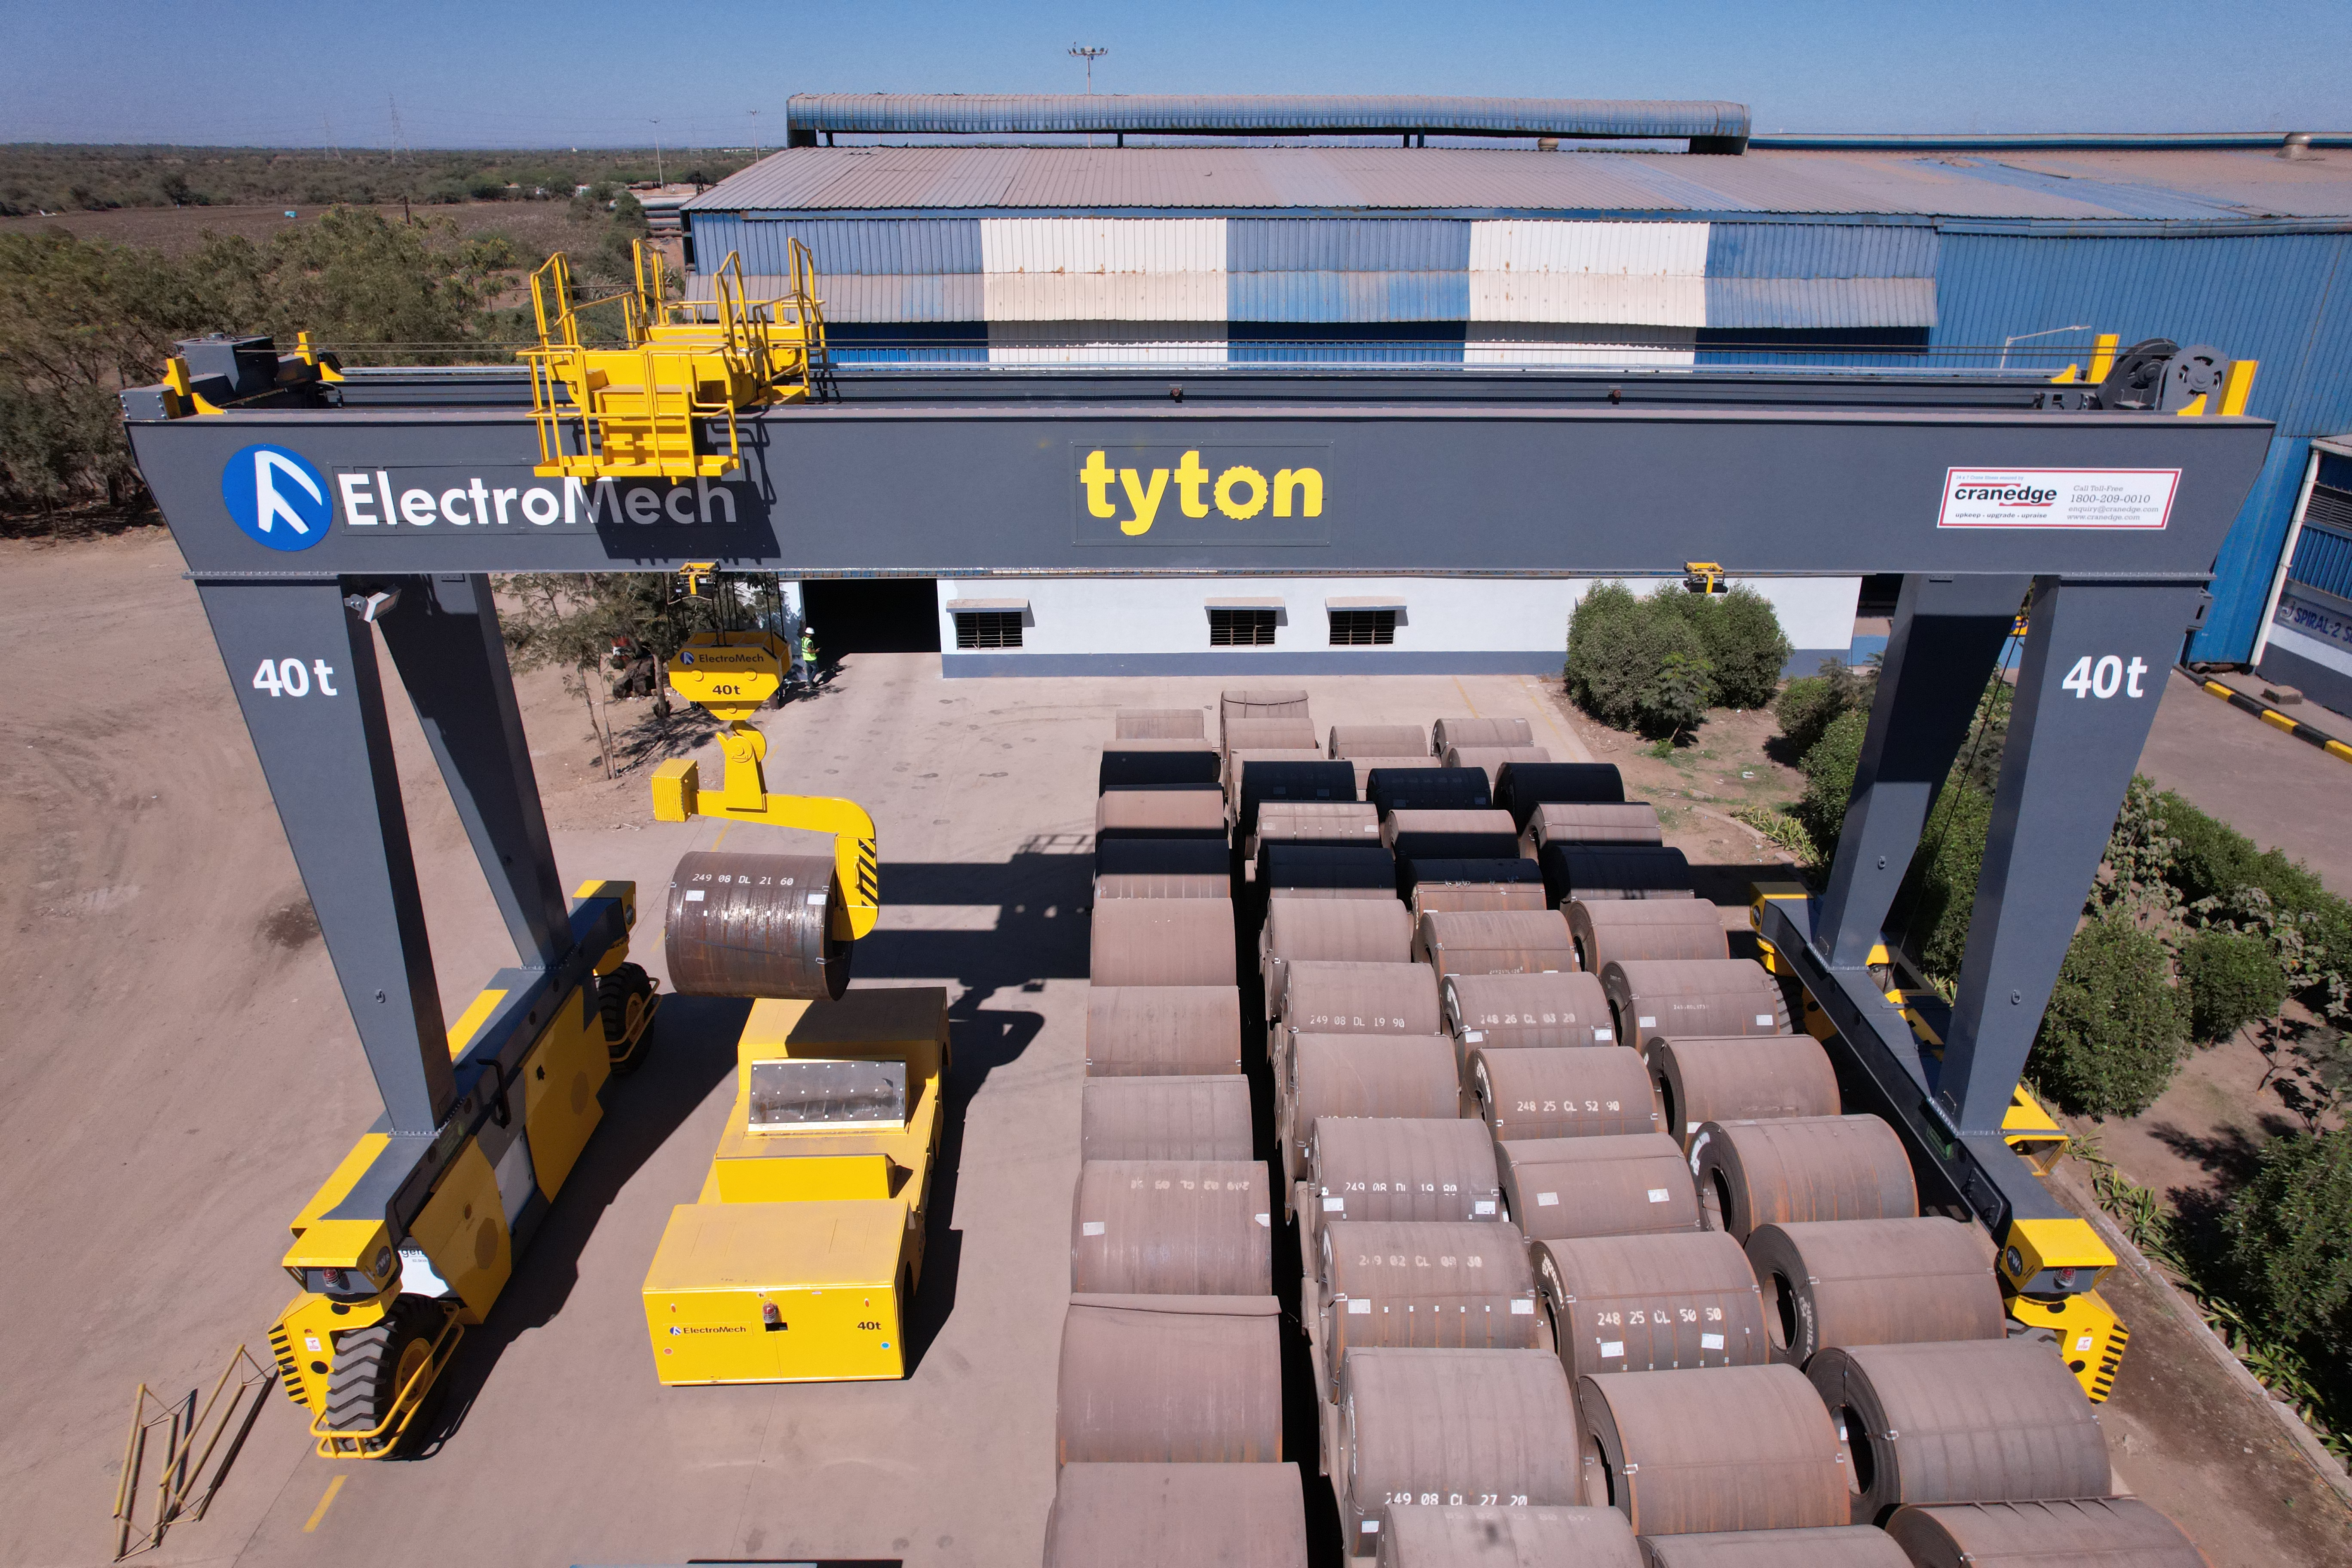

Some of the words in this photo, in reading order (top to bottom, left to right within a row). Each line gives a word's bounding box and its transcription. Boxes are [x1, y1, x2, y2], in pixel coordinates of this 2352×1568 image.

[338, 471, 737, 527] ElectroMech
[1080, 450, 1323, 536] tyton
[1954, 486, 2057, 504] cranedge
[2070, 494, 2150, 503] 1800-209-0010
[698, 654, 764, 663] ElectroMech
[692, 873, 712, 882] 249
[718, 875, 732, 883] 08
[738, 876, 751, 884] DL
[759, 876, 771, 885] 21
[1310, 1015, 1328, 1024] 249
[1334, 1016, 1346, 1026] 08
[1354, 1017, 1365, 1026] DL
[1375, 1017, 1385, 1027] 19
[1523, 1014, 1537, 1023] CL
[1517, 1101, 1537, 1112] 248
[1543, 1100, 1556, 1112] 25
[1564, 1100, 1577, 1112] CL
[1585, 1100, 1599, 1112] 52
[1346, 1182, 1365, 1191] 249
[1598, 1312, 1621, 1326] 248
[1629, 1311, 1645, 1324] 25
[683, 1326, 747, 1335] ElectroMech
[857, 1321, 882, 1331] 40t
[1385, 1492, 1412, 1505] 249
[1421, 1493, 1439, 1506] 08
[1480, 1494, 1498, 1506] 27
